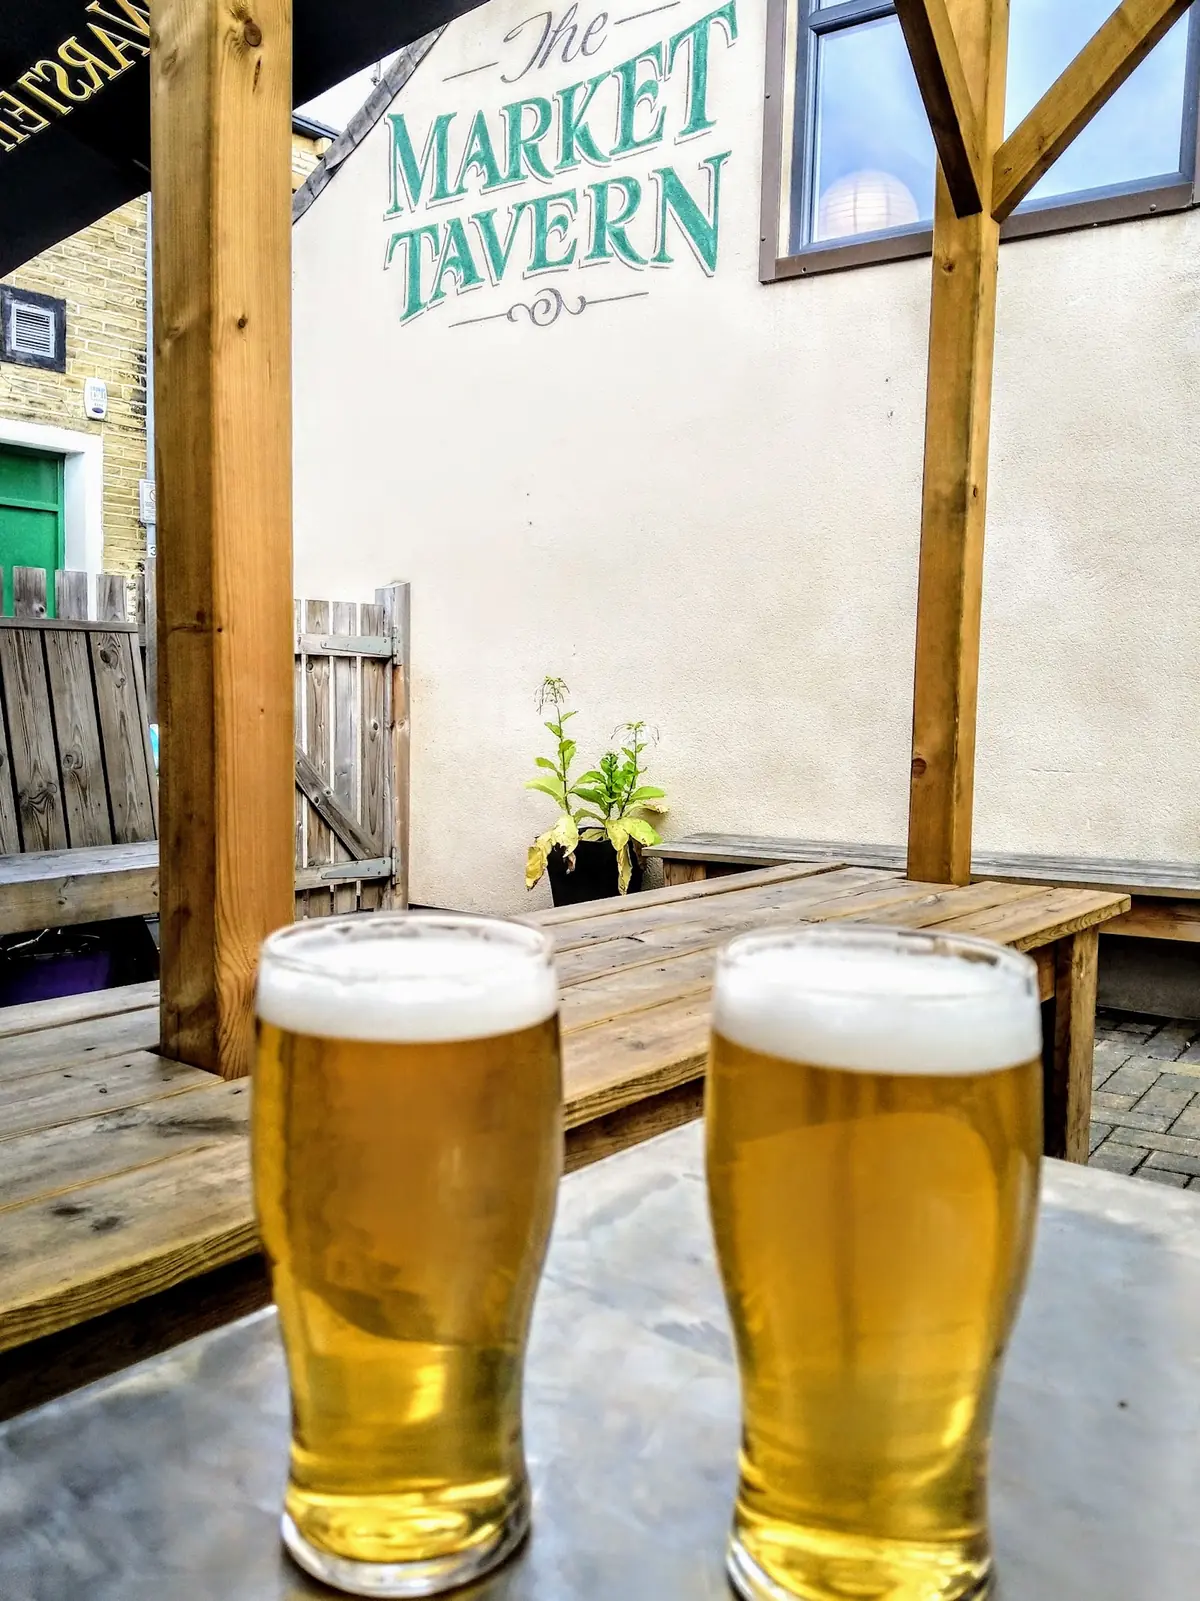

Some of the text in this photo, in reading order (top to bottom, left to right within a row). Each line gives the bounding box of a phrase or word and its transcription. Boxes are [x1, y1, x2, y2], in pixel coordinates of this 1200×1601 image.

[383, 0, 738, 222] MARKET
[500, 2, 608, 83] The
[384, 150, 732, 326] TAVERN
